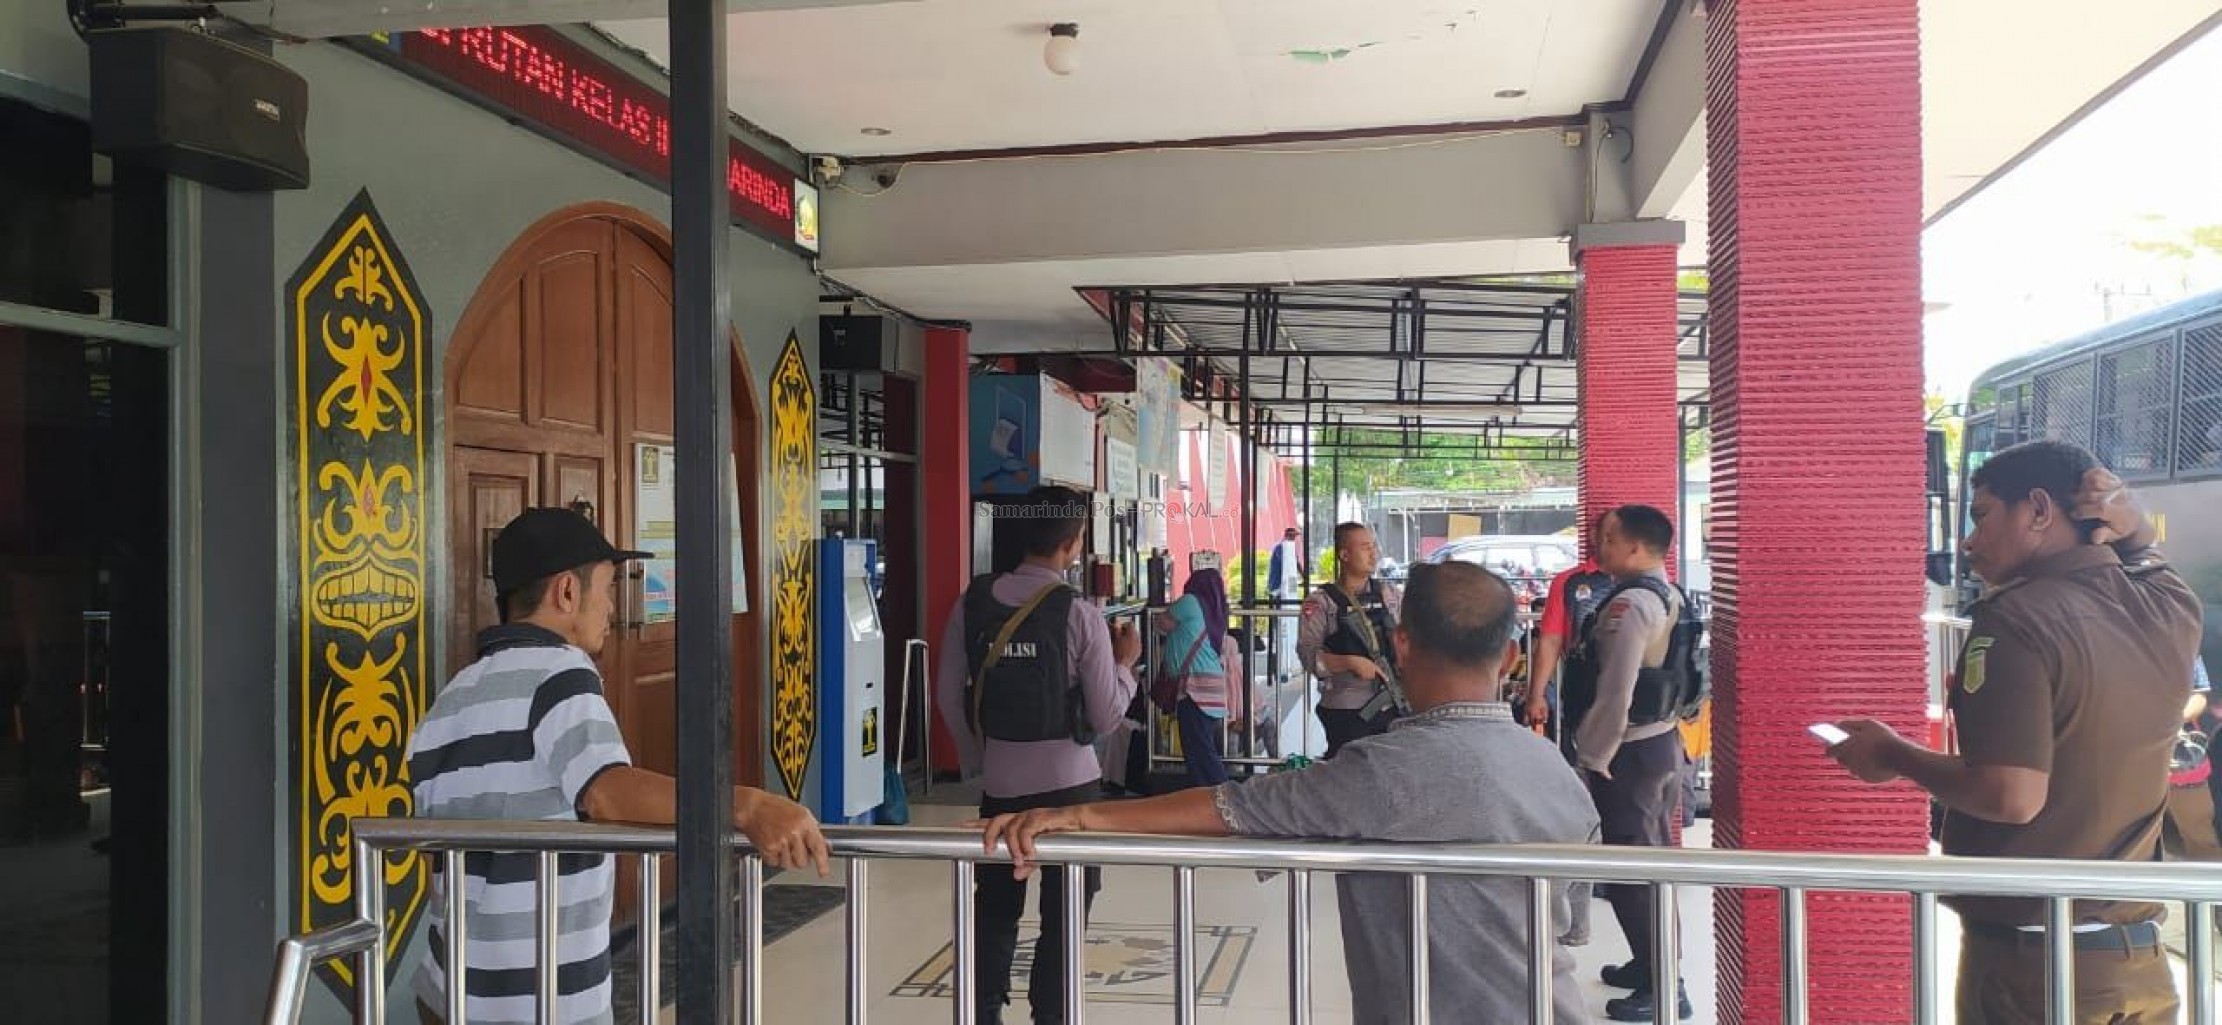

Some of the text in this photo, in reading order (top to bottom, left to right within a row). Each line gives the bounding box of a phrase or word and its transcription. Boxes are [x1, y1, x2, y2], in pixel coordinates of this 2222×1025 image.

[460, 25, 566, 99] RUTAN
[572, 68, 651, 145] KELAS
[728, 157, 791, 220] ARINDA
